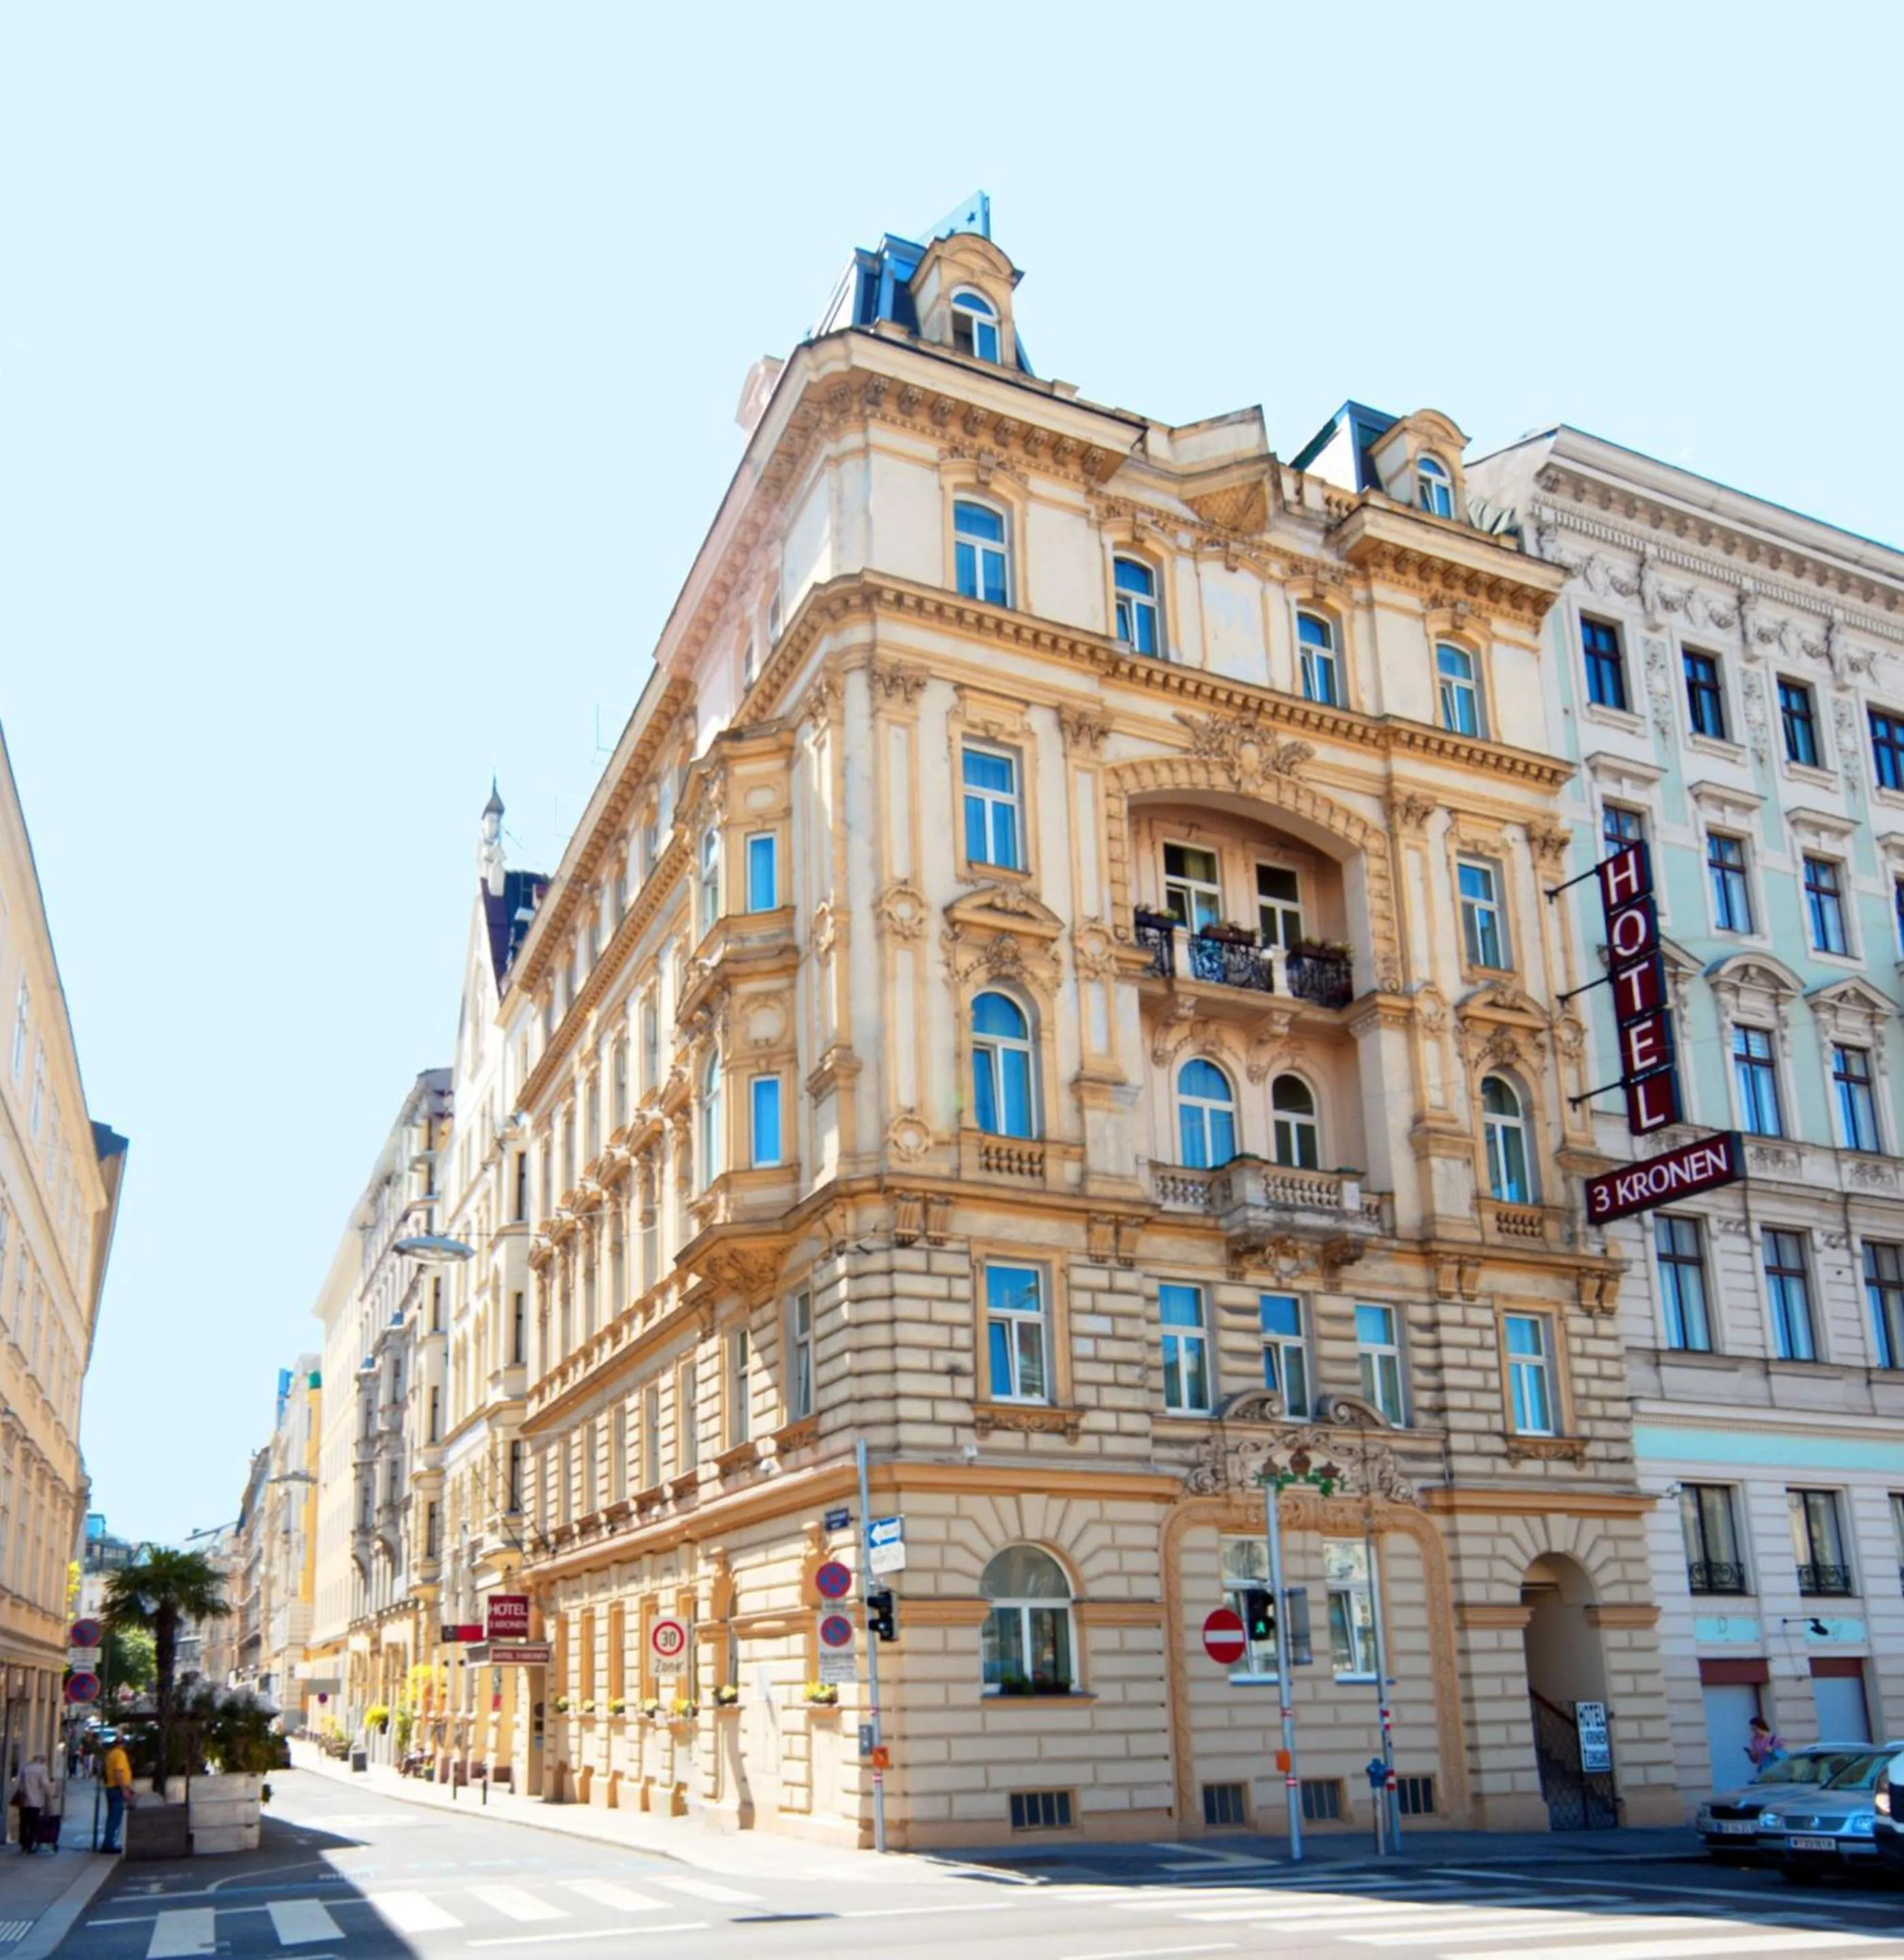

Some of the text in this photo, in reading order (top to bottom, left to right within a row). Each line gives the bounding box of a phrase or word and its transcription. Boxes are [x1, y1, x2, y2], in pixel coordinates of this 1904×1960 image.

[1606, 849, 1665, 1129] HOTEL
[1593, 1144, 1728, 1212] 3 KRONEN
[488, 1603, 528, 1616] HOTEL
[495, 1620, 528, 1630] KRONEN
[660, 1630, 677, 1647] 30
[654, 1658, 683, 1673] Zone
